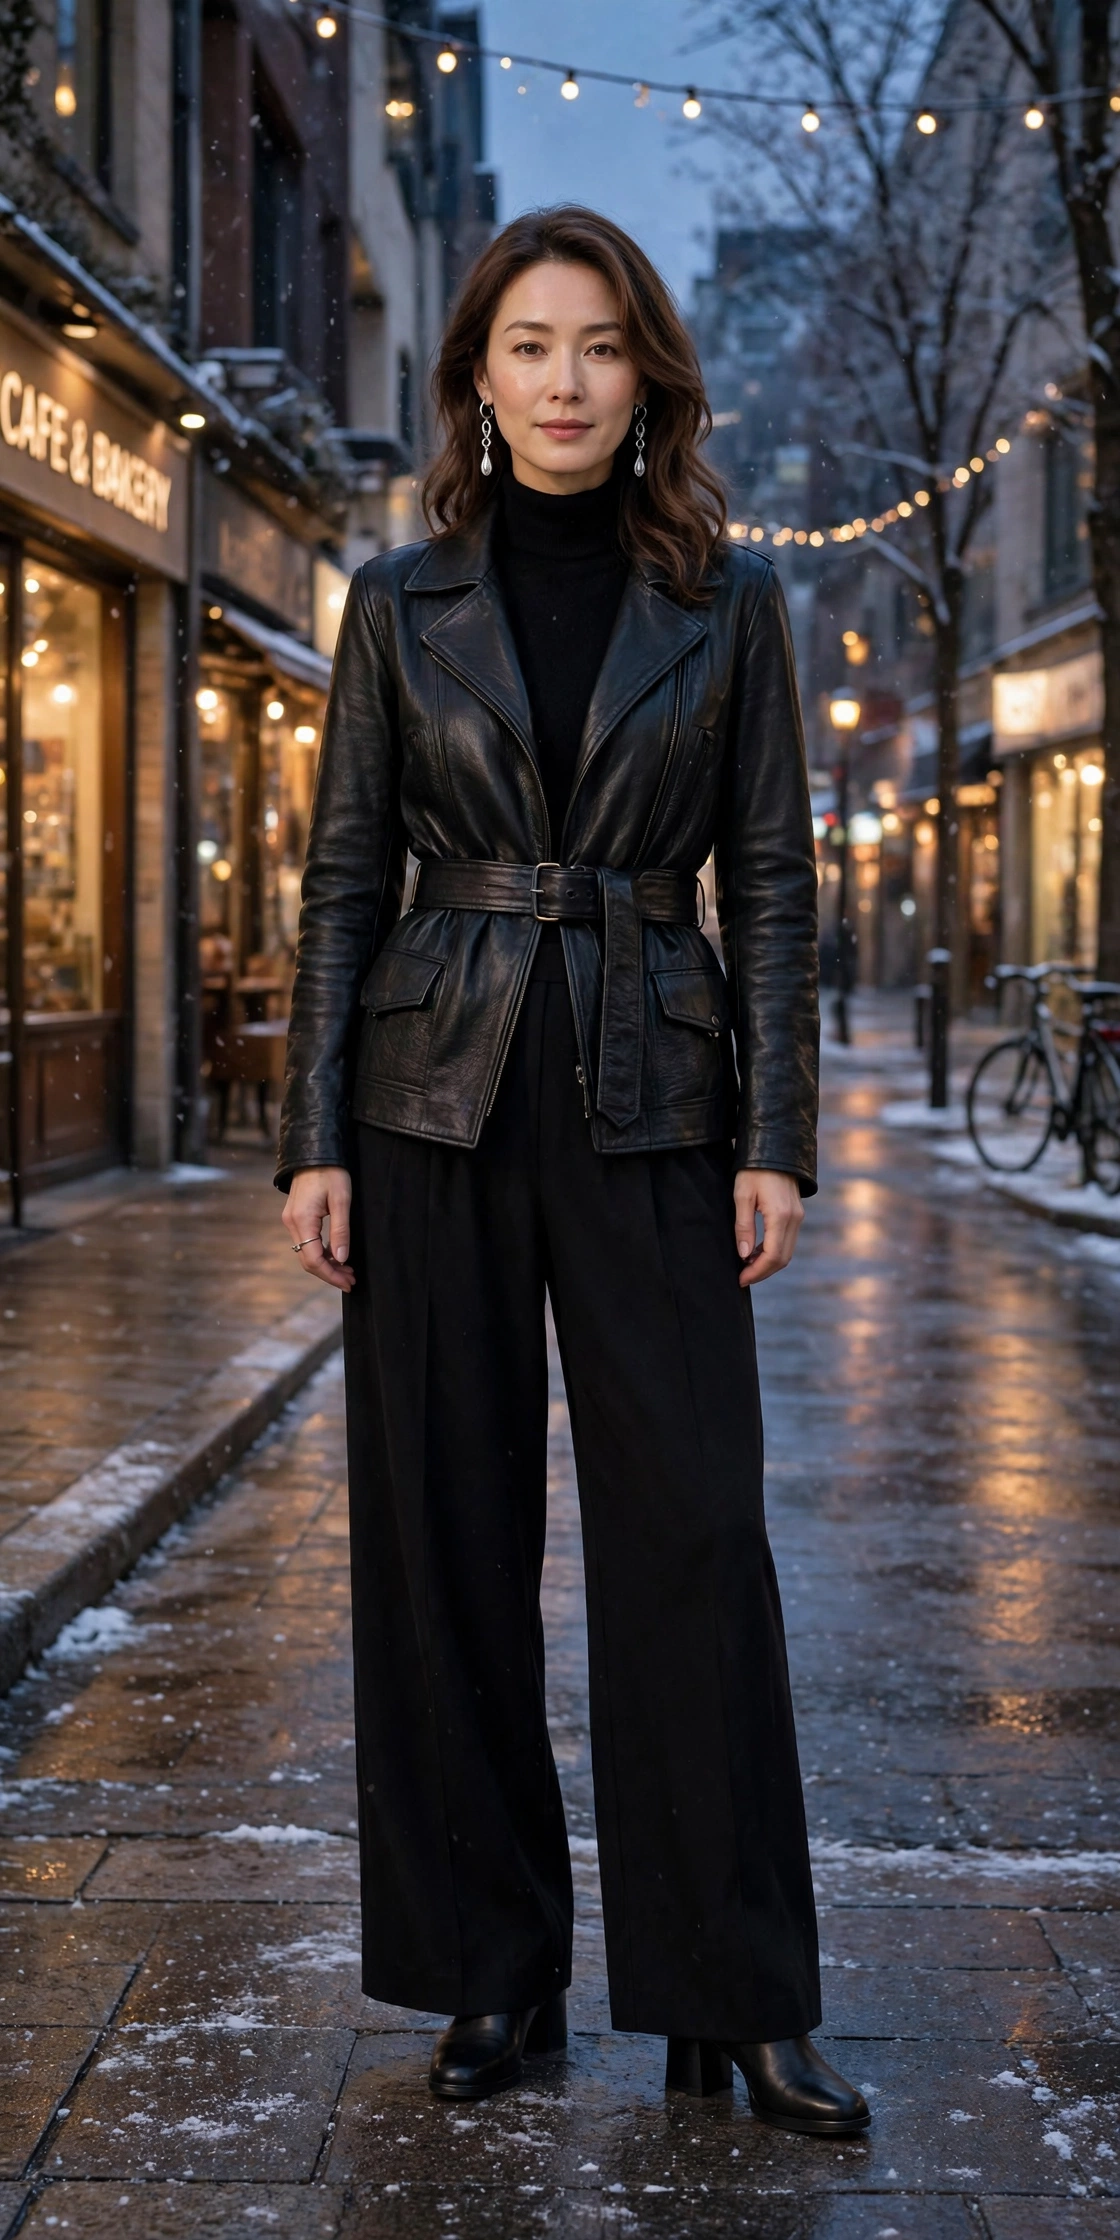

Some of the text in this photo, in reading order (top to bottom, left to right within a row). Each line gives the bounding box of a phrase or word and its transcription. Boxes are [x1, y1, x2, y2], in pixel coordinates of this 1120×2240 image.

[0, 371, 172, 533] CAFE & BAKERY
